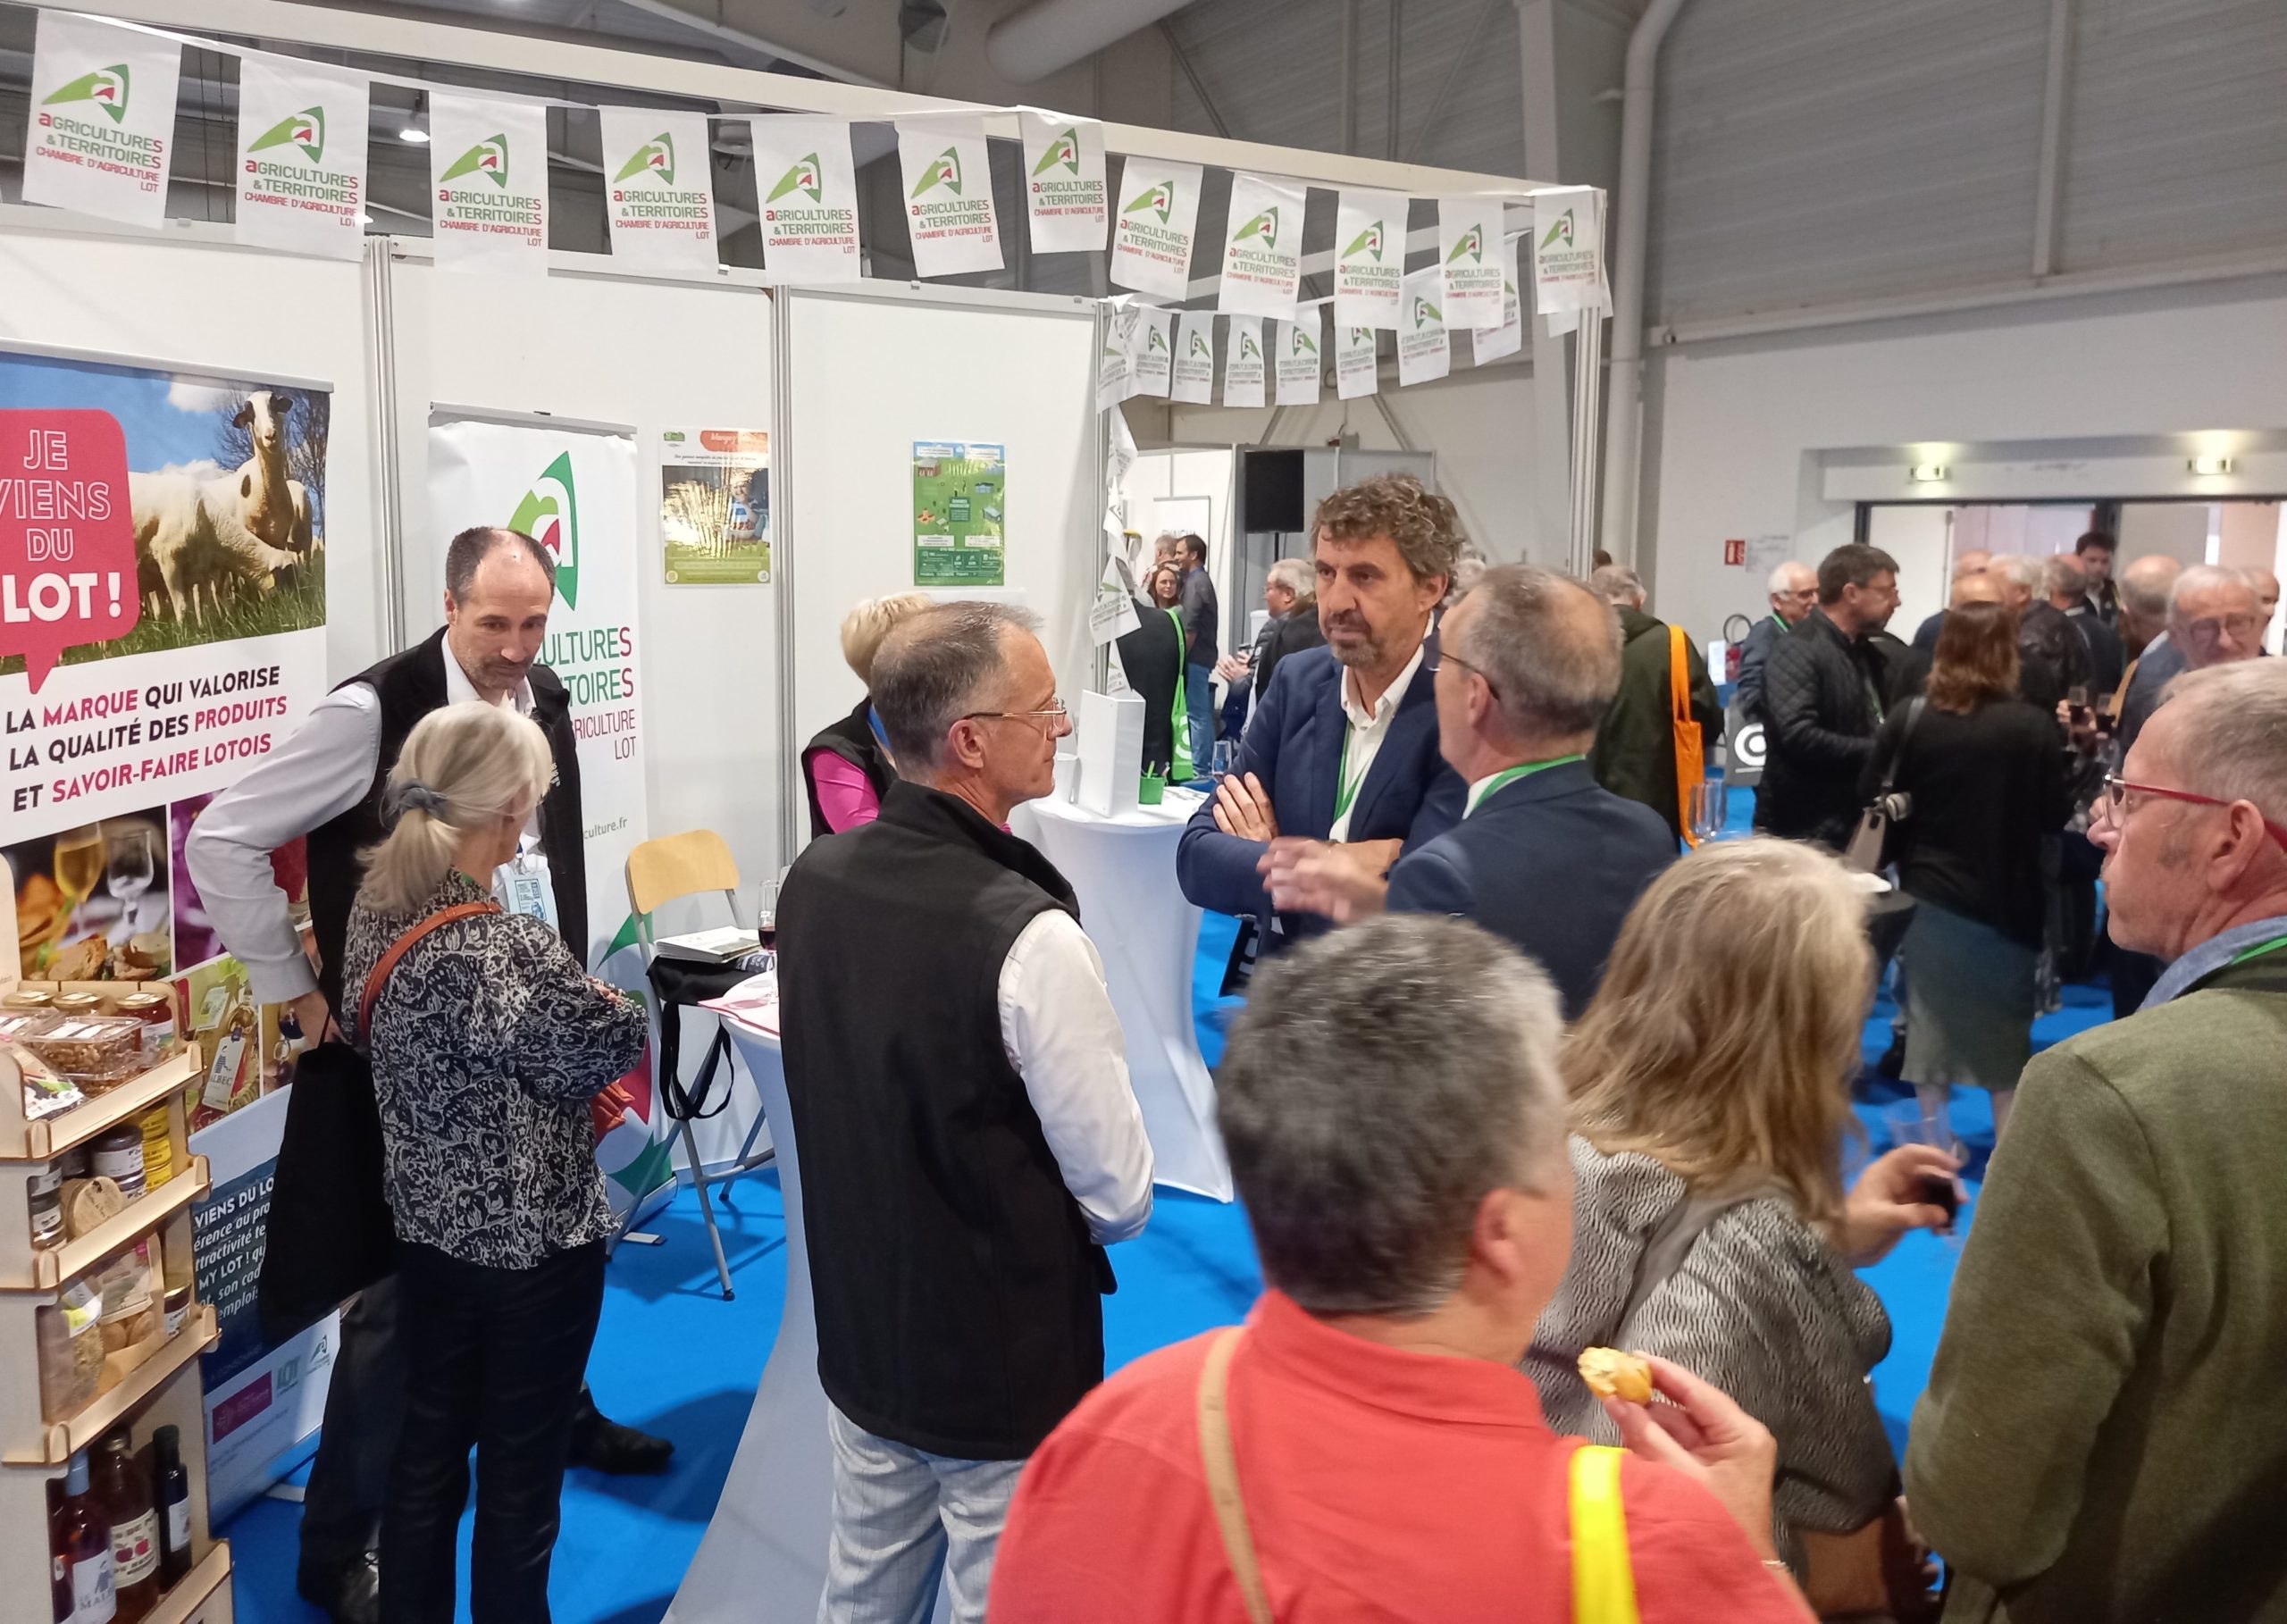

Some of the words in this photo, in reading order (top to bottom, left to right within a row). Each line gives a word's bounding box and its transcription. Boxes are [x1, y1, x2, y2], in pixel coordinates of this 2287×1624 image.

[46, 134, 56, 146] &
[57, 134, 161, 169] TERRITOIRES
[36, 146, 84, 165] CHAMBRE
[88, 158, 160, 182] D'AGRICULTURE
[140, 182, 159, 193] LOT
[244, 191, 289, 206] CHAMBRE
[253, 180, 262, 190] &
[263, 178, 358, 205] TERRITOIRES
[1044, 194, 1104, 205] TERRITOIRES
[447, 207, 455, 218] &
[456, 205, 542, 225] TERRITOIRES
[622, 207, 629, 217] &
[630, 205, 708, 219] TERRITOIRES
[919, 221, 926, 229] &
[926, 213, 992, 228] TERRITOIRES
[440, 220, 480, 232] CHAMBRE
[482, 225, 542, 238] D'AGRICULTURE
[616, 220, 652, 229] CHAMBRE
[655, 221, 709, 230] D'AGRICULTURE
[696, 231, 710, 239] LOT
[774, 226, 781, 235] &
[782, 223, 854, 235] TERRITOIRES
[527, 238, 542, 247] LOT
[768, 238, 802, 247] CHAMBRE
[804, 237, 855, 246] D'AGRICULTURE
[843, 246, 855, 254] LOT
[983, 235, 993, 243] LOT
[1129, 233, 1187, 257] TERRITOIRES
[1238, 261, 1295, 279] TERRITOIRES
[23, 429, 68, 471] JE
[27, 528, 73, 562] DU
[2, 572, 98, 624] LOT
[538, 626, 632, 666] ULTURES
[560, 667, 634, 707] TOIRES
[5, 708, 36, 734] LA
[43, 689, 138, 728] MARQUE
[145, 682, 182, 709] QUI
[188, 666, 281, 699] VALORISE
[9, 745, 39, 771] LA
[48, 716, 141, 764] QUALITÉ
[148, 714, 189, 741] DES
[194, 696, 288, 732] PRODUITS
[571, 708, 636, 741] RICULTURE
[615, 736, 636, 760] LOT
[13, 783, 44, 812] ET
[52, 749, 198, 803] SAVOIR-FAIRE
[204, 733, 272, 766] LOTOIS
[195, 1197, 235, 1228] VIENS
[239, 1185, 256, 1208] DU
[194, 1222, 232, 1251] érence
[235, 1213, 250, 1229] au
[252, 1202, 271, 1224] pro
[198, 1268, 217, 1291] MY
[221, 1254, 243, 1278] LOT
[218, 1280, 239, 1301] son
